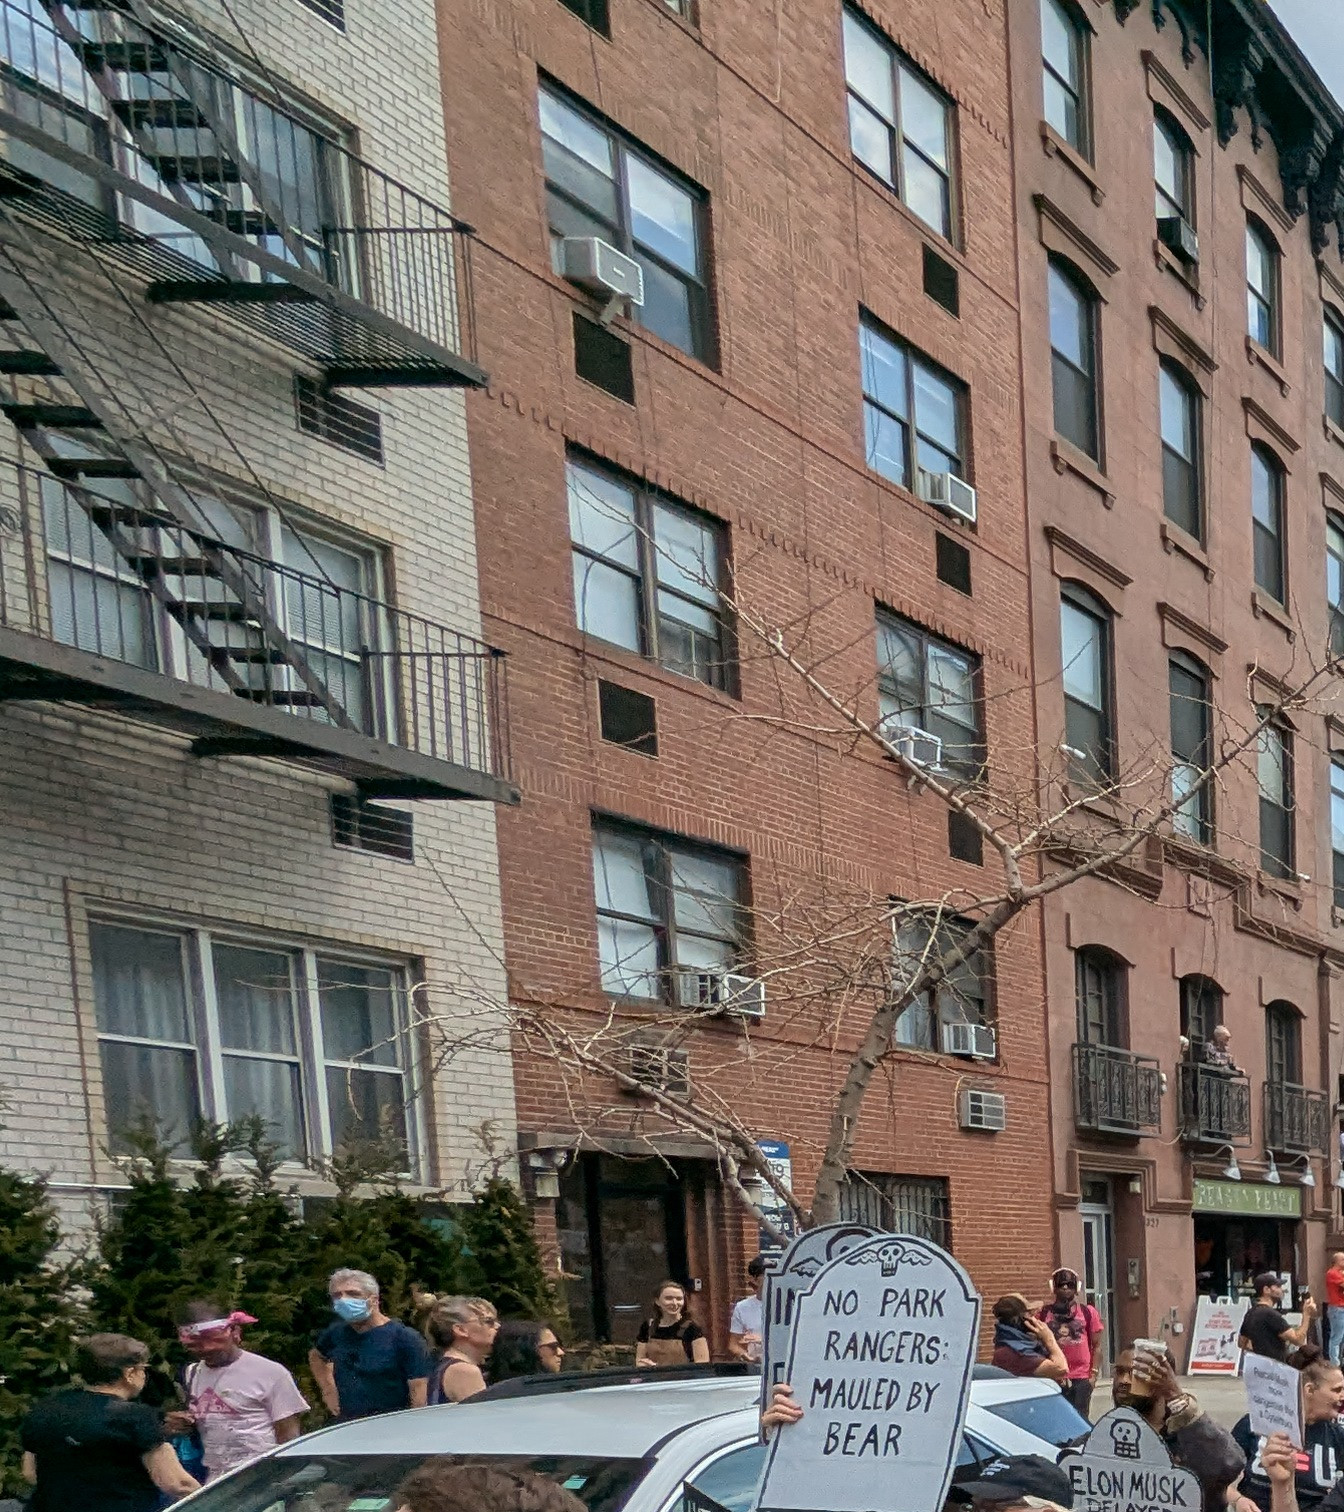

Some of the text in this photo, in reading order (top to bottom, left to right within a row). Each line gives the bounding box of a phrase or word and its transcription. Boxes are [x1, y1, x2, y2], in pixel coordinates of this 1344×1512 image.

[823, 1289, 859, 1316] NO
[879, 1288, 946, 1317] PARK
[824, 1330, 950, 1364] RANGERS:
[810, 1377, 941, 1413] MAULED BY
[823, 1421, 902, 1457] BEAR
[1069, 1465, 1187, 1507] ELON MUSK
